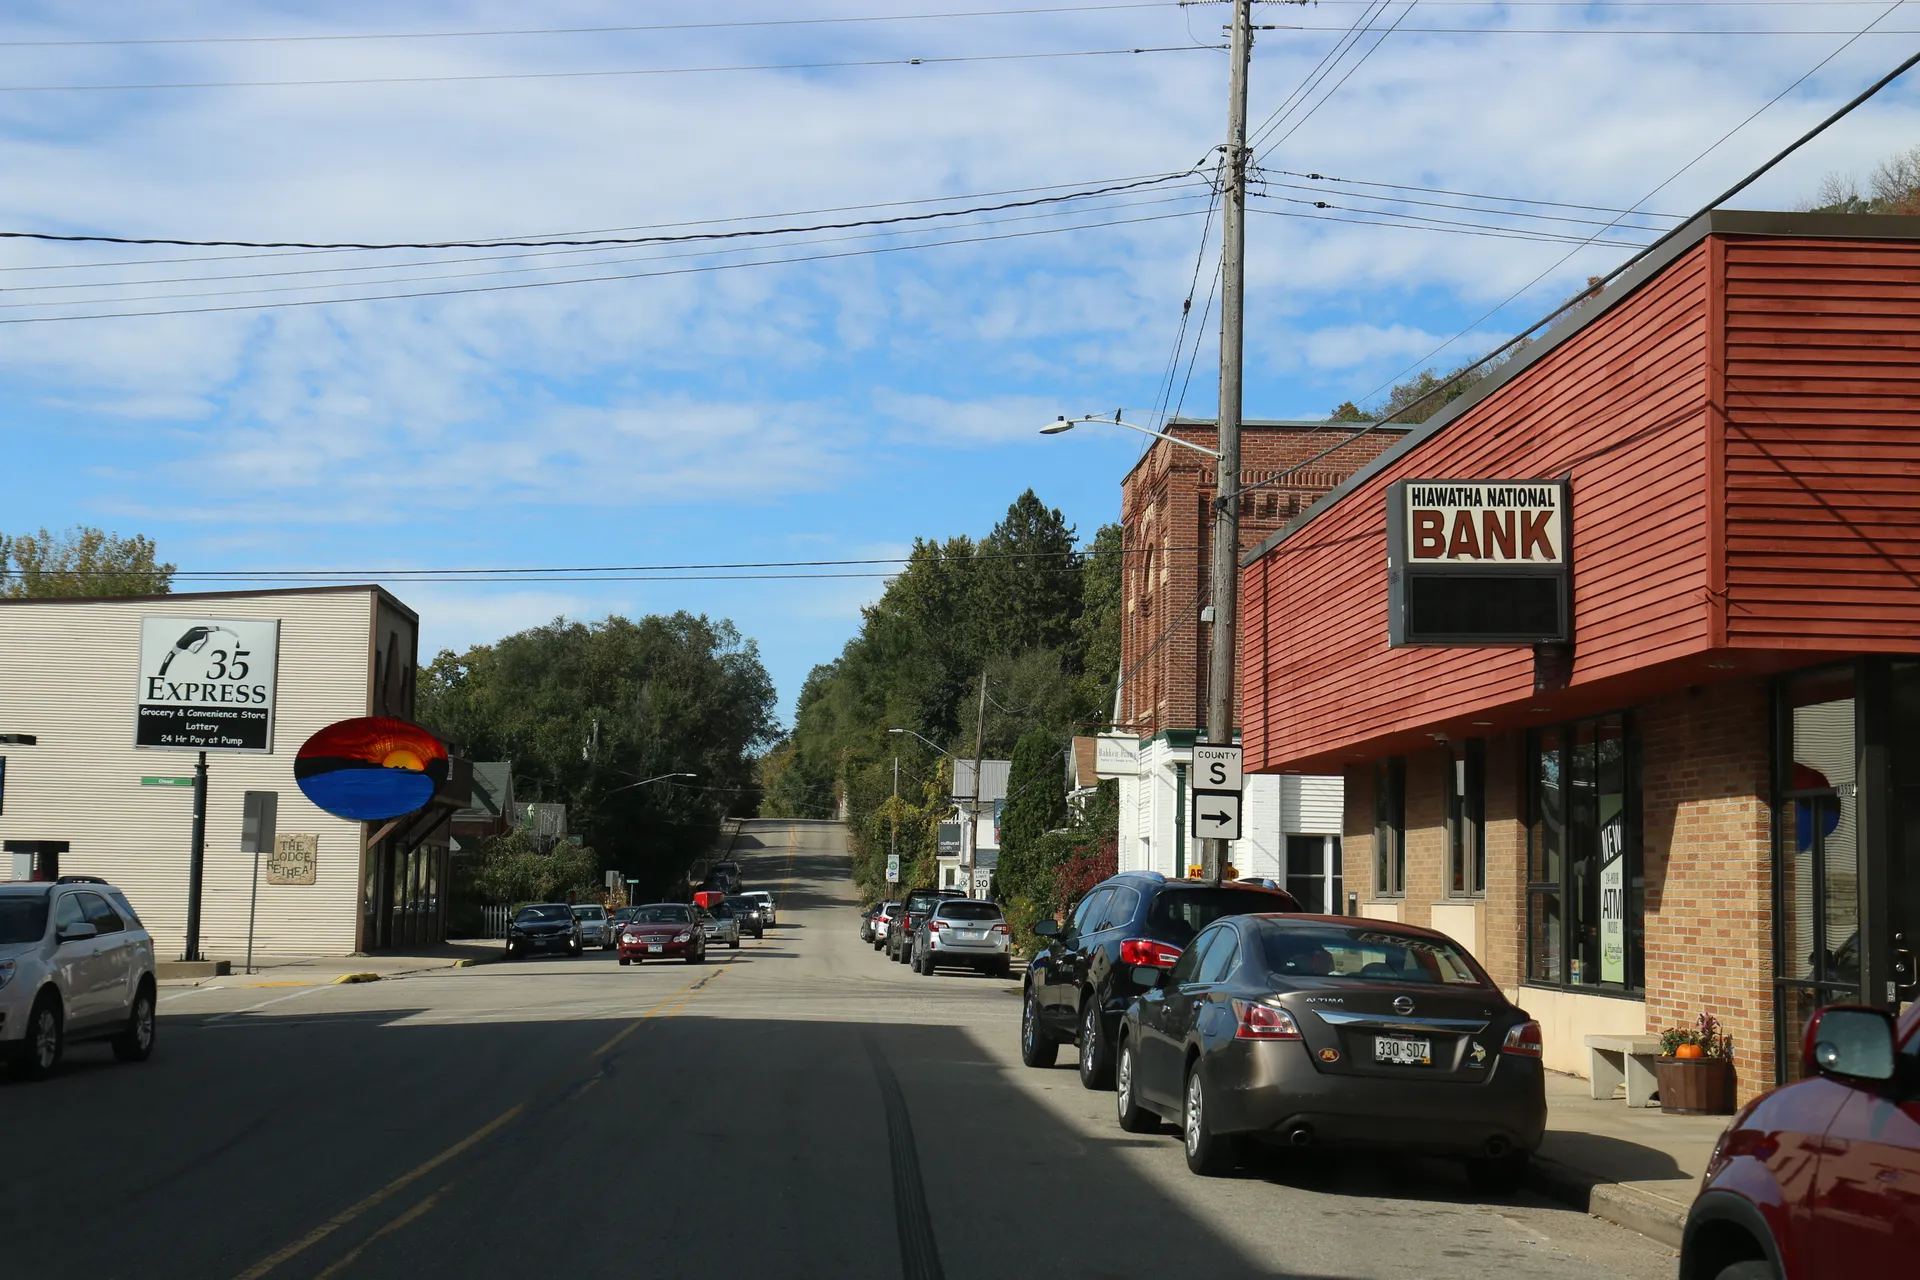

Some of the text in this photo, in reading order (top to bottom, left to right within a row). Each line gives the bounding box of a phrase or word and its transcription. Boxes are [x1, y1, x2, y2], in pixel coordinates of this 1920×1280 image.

[1412, 487, 1555, 507] HIAWATHA NATIONAL
[1412, 510, 1557, 560] BANK
[206, 649, 251, 680] 35
[146, 676, 266, 704] EXPRESS
[141, 707, 266, 719] Grocery & Convenience Store
[186, 722, 219, 732] Lottery
[161, 734, 172, 742] 24
[175, 735, 187, 743] Hr
[190, 736, 206, 745] Pay
[221, 736, 243, 746] Pump
[1197, 750, 1237, 760] COUNTY
[1209, 762, 1227, 785] S
[279, 841, 304, 851] THE
[1601, 817, 1621, 863] NEW
[272, 851, 312, 862] LODGE
[266, 860, 317, 879] RETREAT
[975, 879, 988, 888] 30
[1602, 888, 1622, 920] ATM
[1378, 1040, 1427, 1058] 330-SDZ
